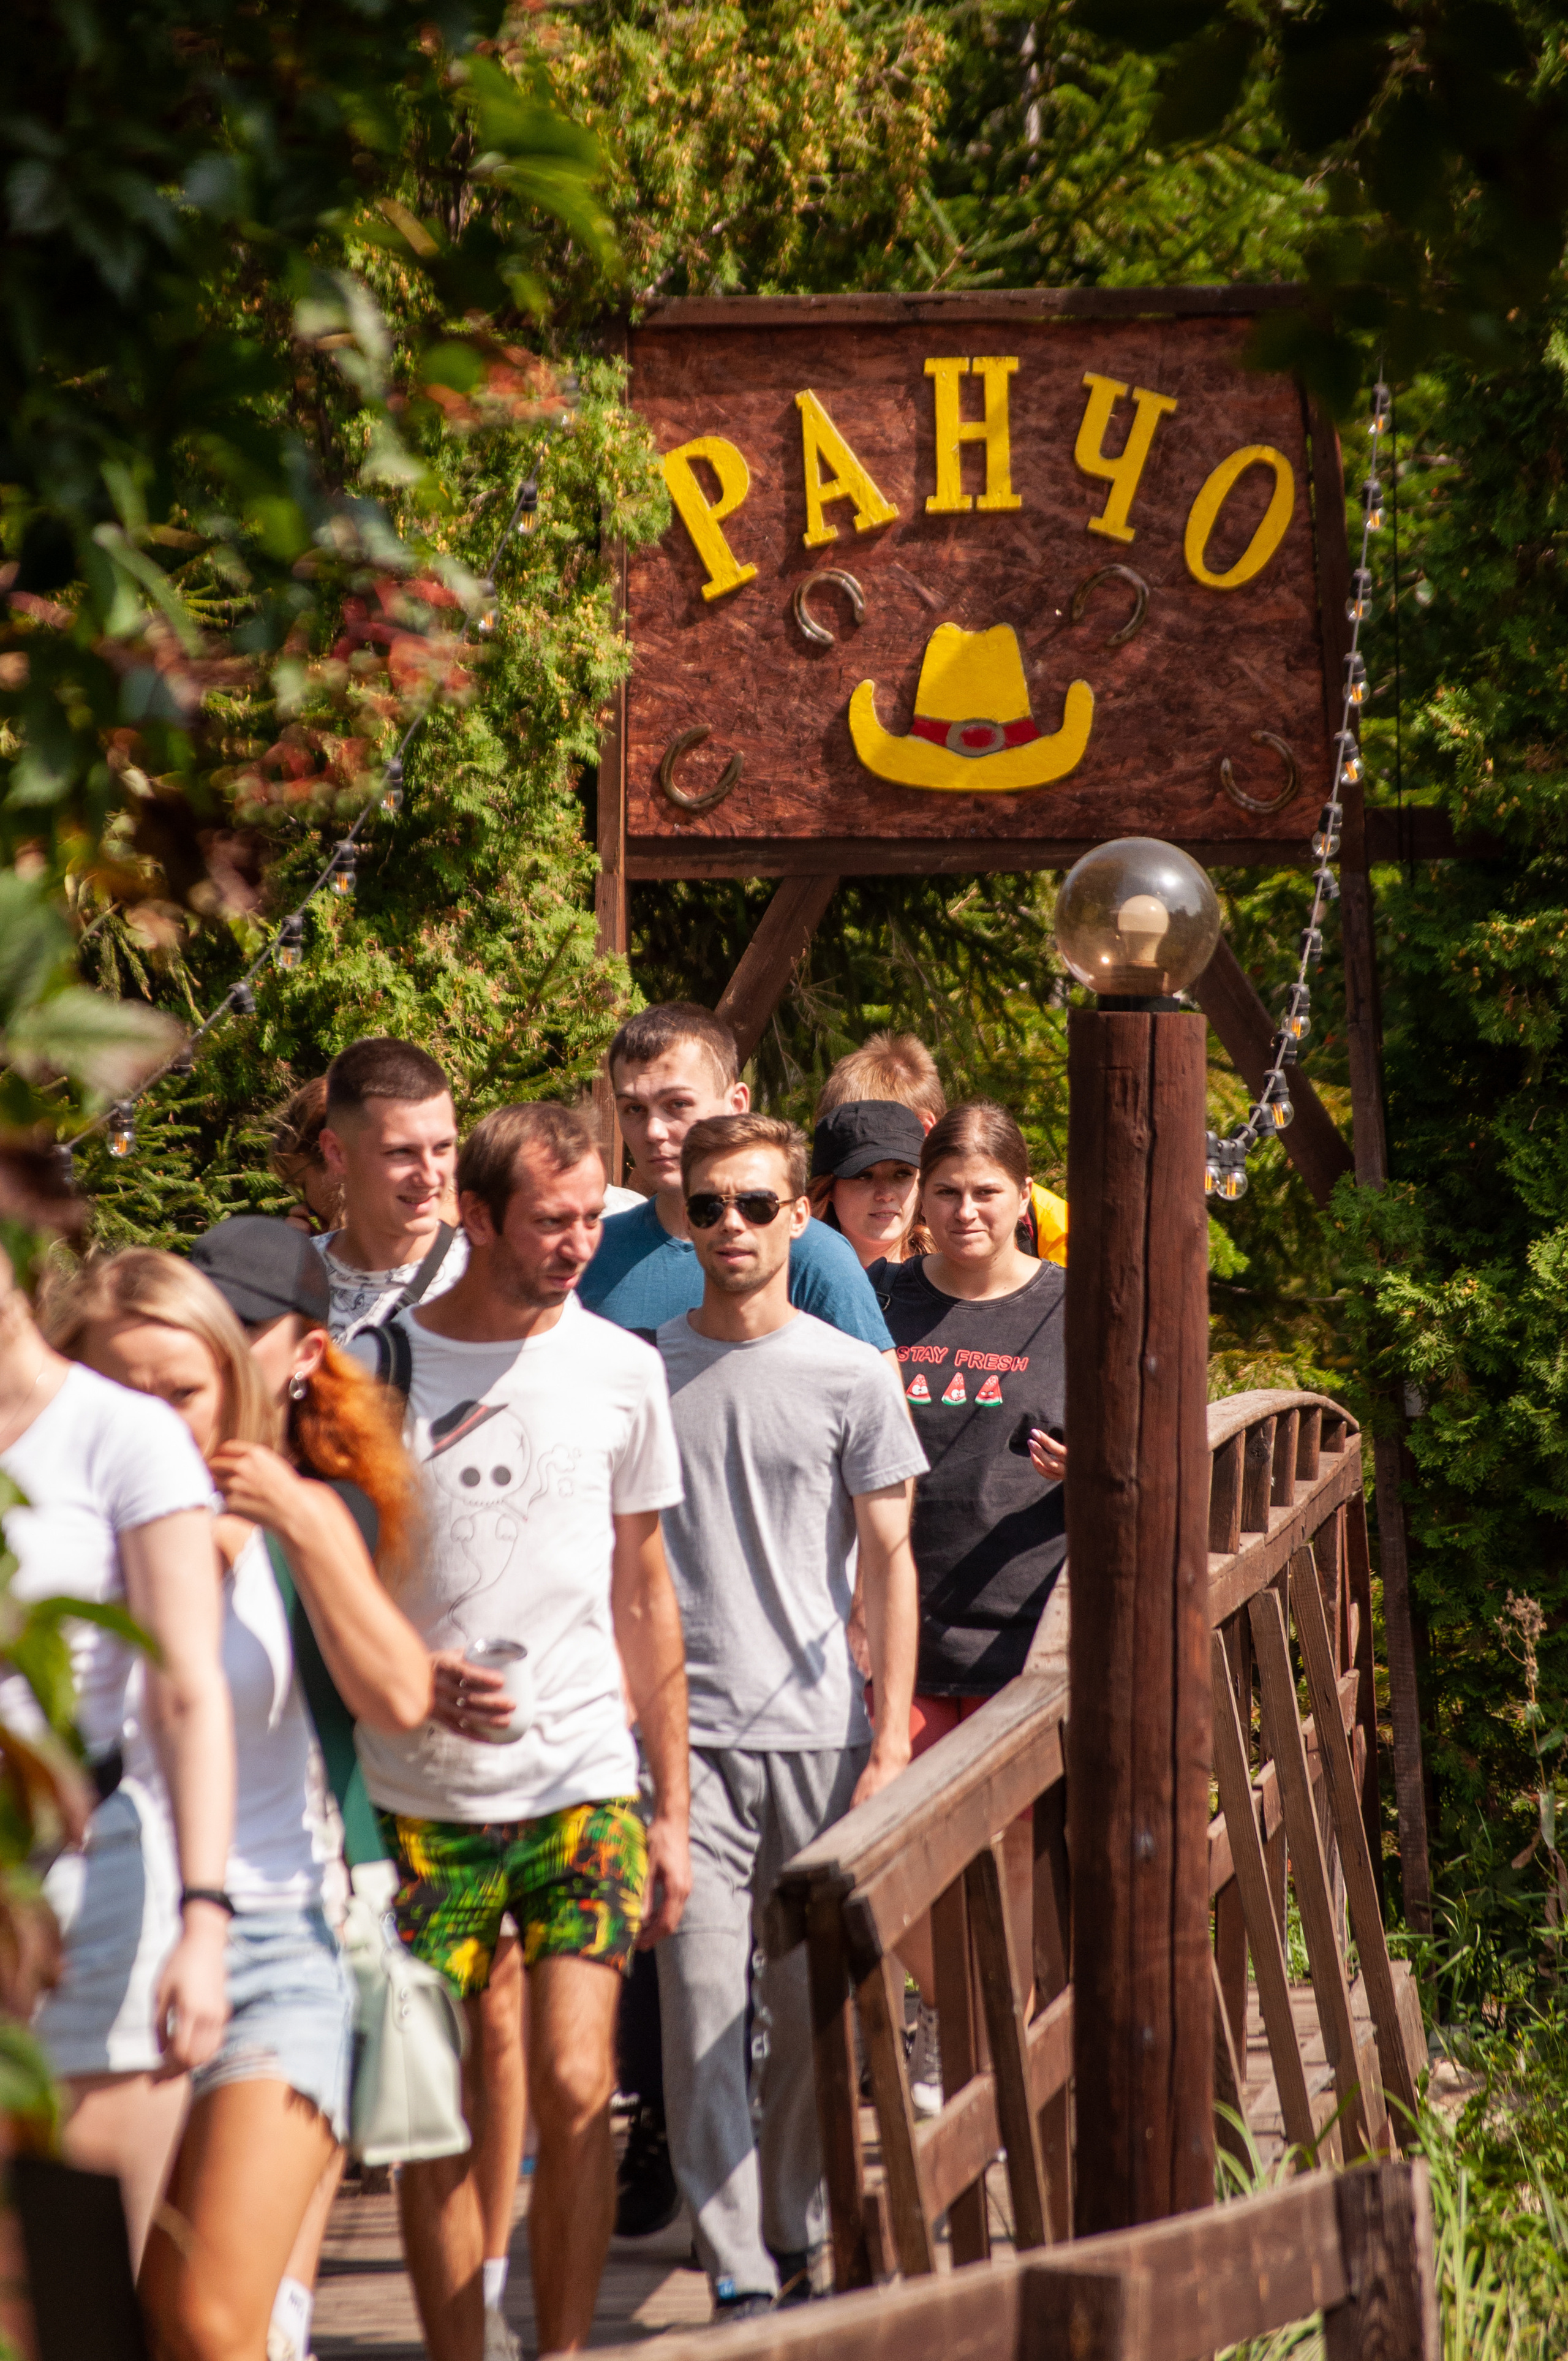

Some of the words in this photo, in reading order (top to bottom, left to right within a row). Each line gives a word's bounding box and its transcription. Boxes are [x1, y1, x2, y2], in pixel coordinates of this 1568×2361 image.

[662, 356, 1295, 603] РАНЧО
[897, 1346, 948, 1364] STAY
[954, 1350, 1029, 1372] FRESH
